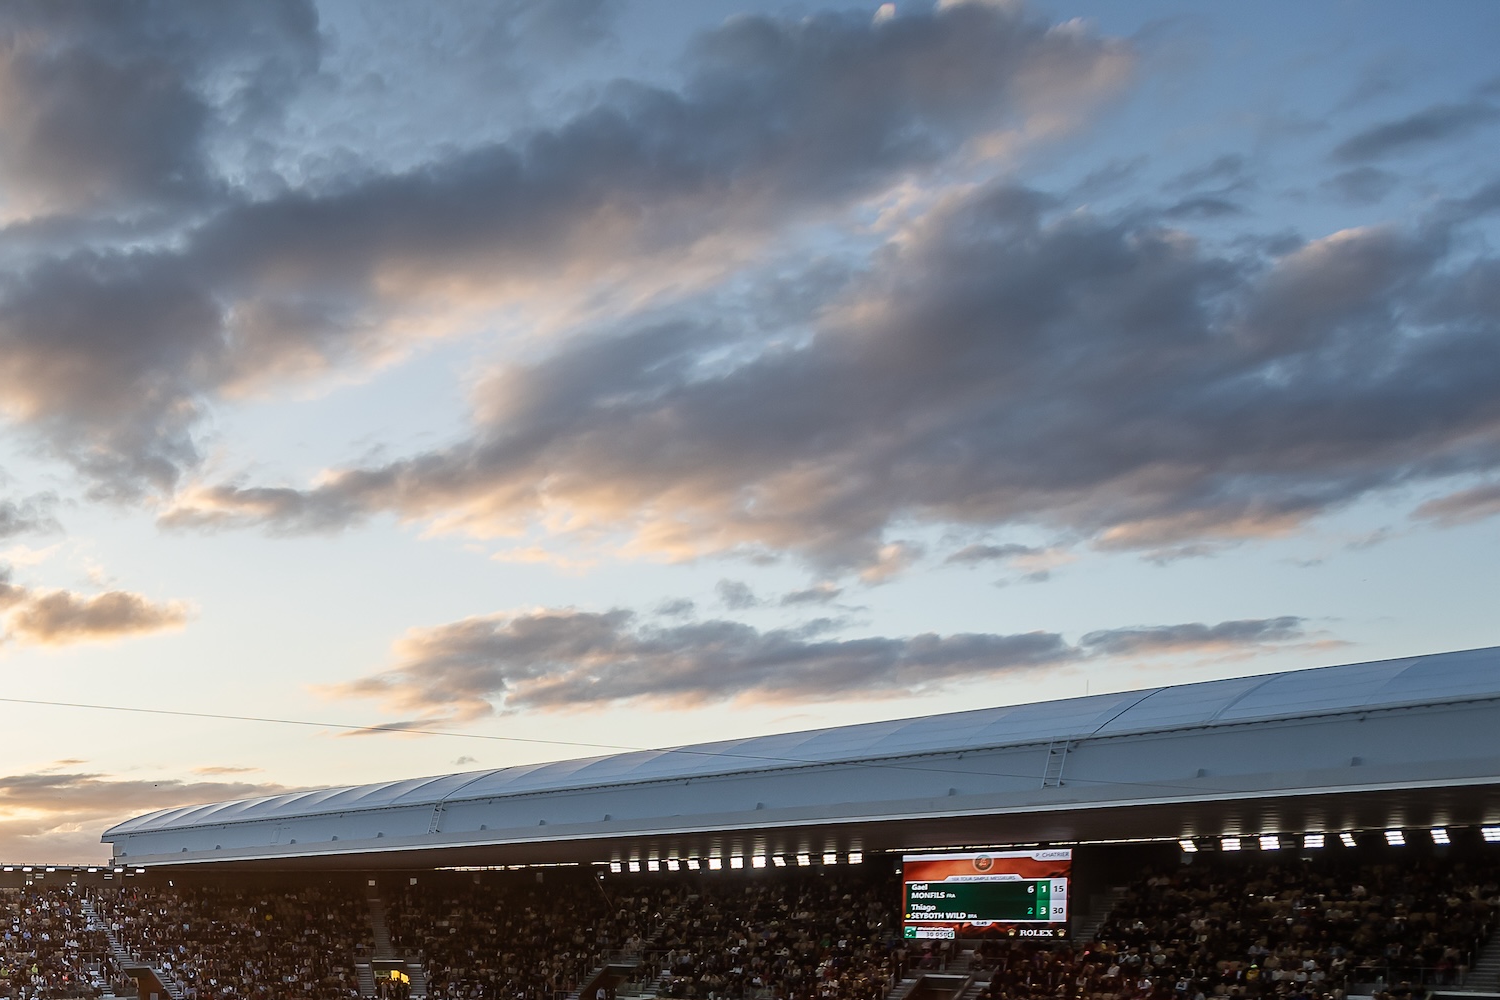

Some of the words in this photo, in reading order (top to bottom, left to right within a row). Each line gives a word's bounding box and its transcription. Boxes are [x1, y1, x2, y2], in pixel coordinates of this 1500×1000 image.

[1027, 885, 1035, 894] 6
[911, 904, 936, 912] Thiago
[1040, 907, 1047, 915] 3
